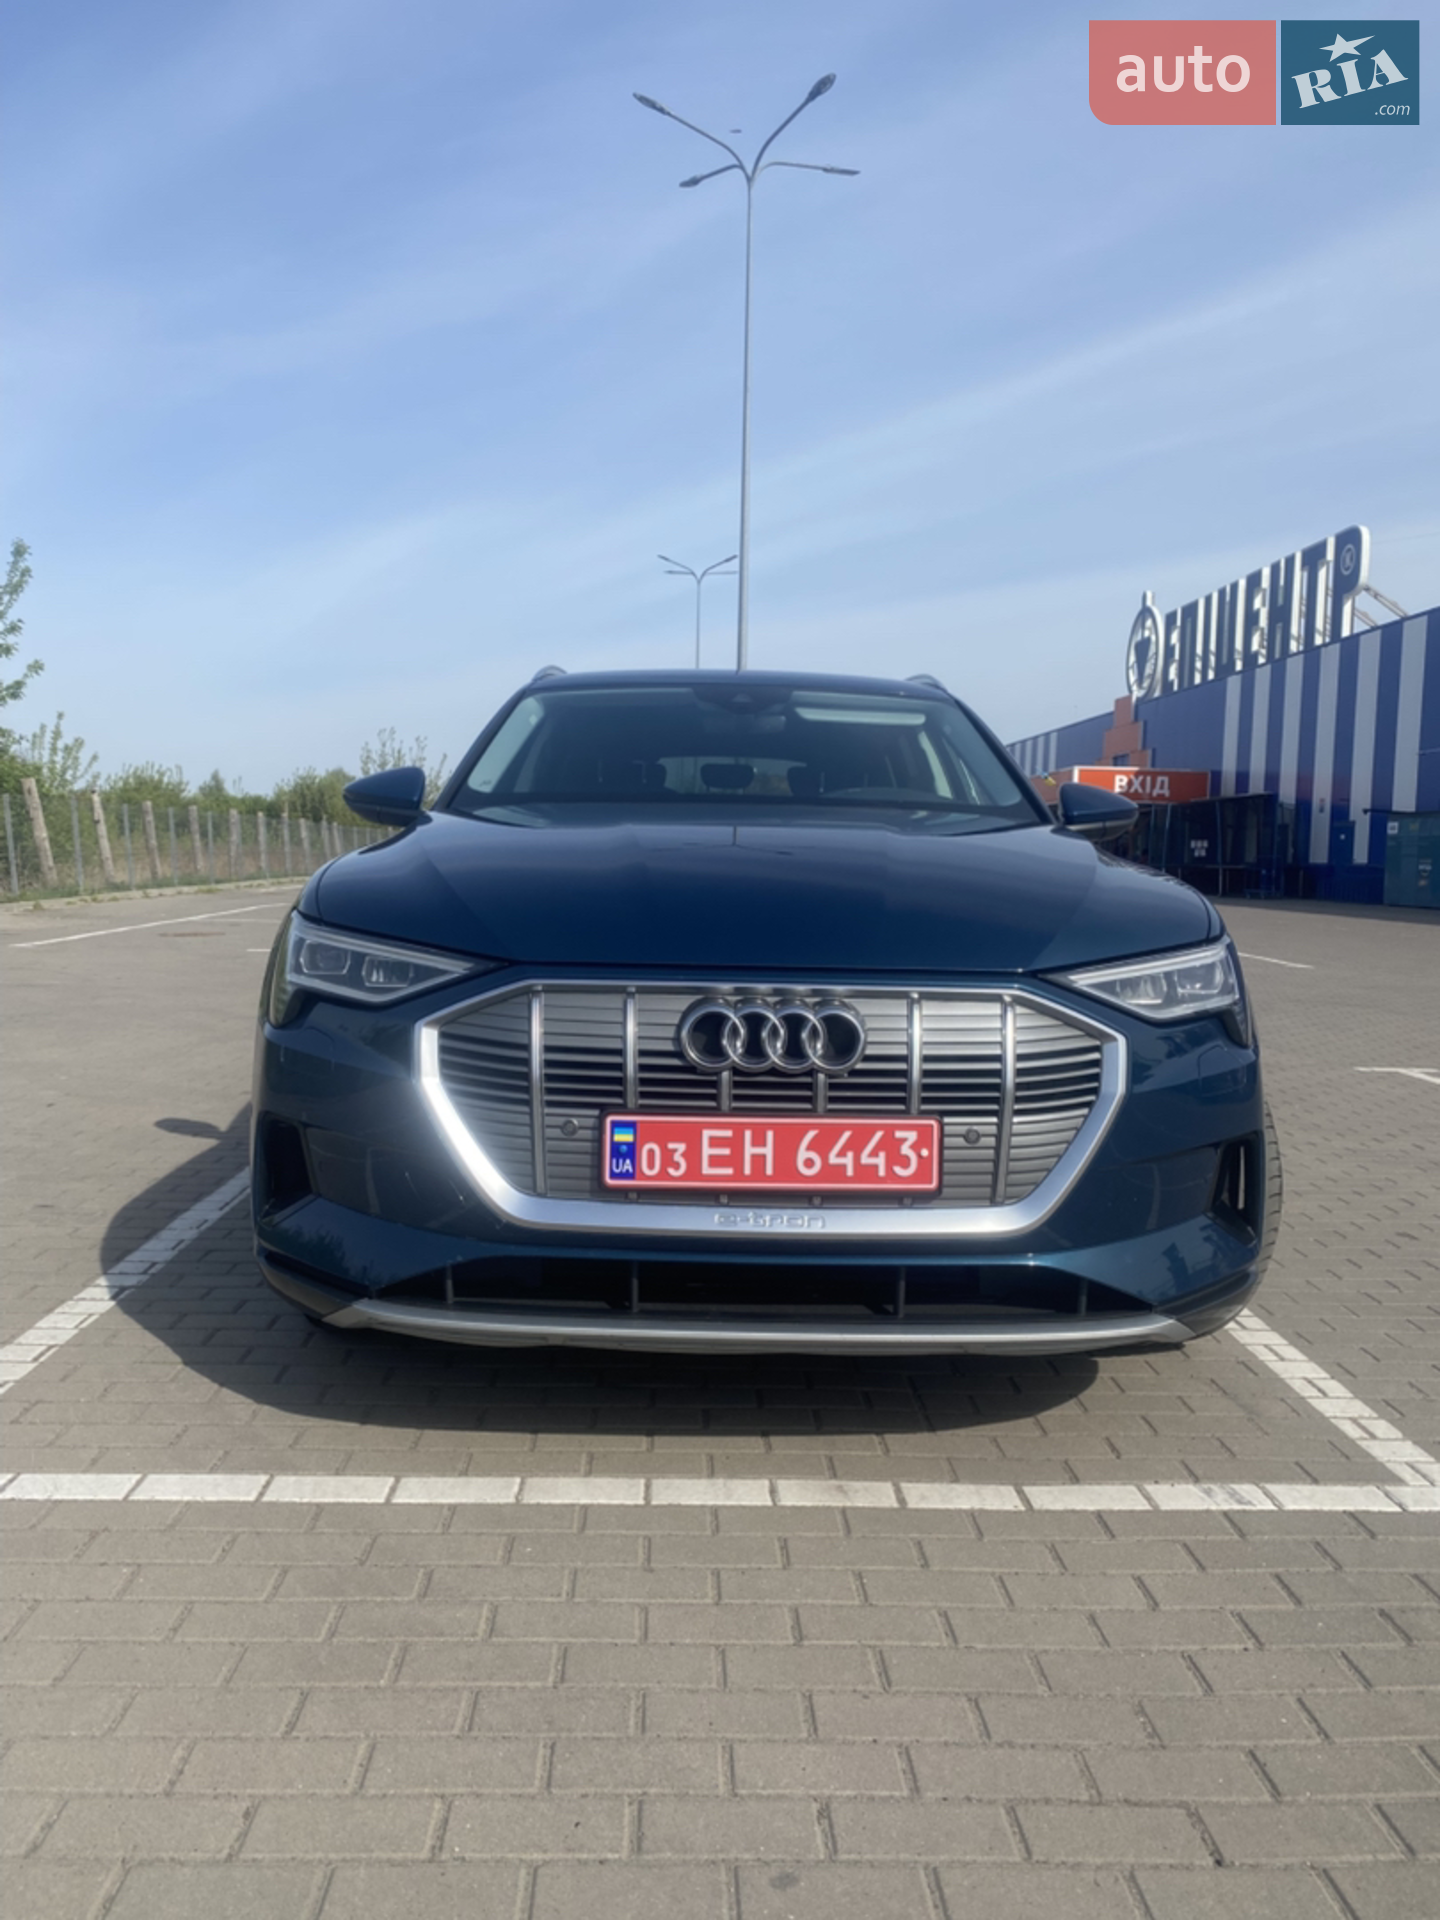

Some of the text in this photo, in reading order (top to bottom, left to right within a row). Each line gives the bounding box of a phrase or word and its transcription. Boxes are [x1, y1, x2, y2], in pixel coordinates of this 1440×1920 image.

[1114, 774, 1170, 797] ВХІД
[640, 1129, 919, 1178] 03 EH 6443
[611, 1157, 633, 1174] UA
[713, 1211, 826, 1229] e-tron
